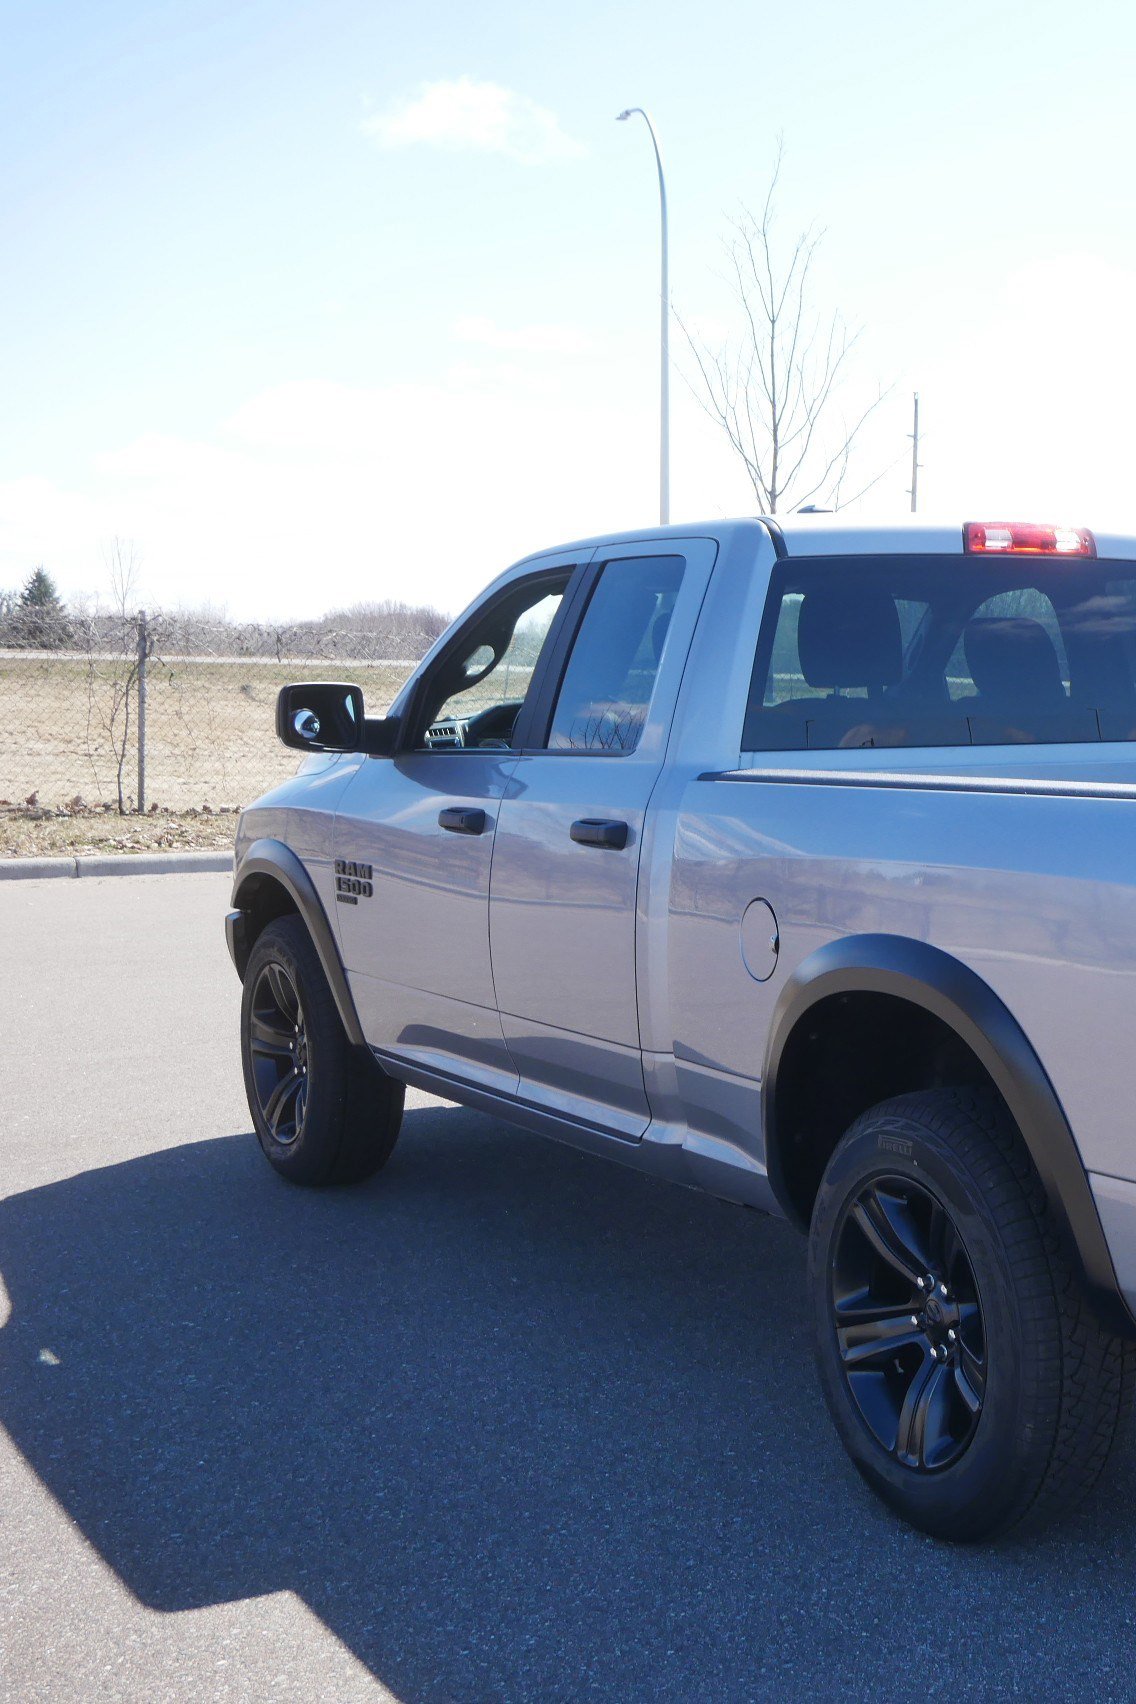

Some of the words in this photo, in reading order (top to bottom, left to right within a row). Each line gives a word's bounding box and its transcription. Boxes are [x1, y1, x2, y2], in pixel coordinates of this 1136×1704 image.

[335, 859, 373, 880] RAM
[335, 876, 374, 898] 1500
[877, 1133, 914, 1157] PIRELLI
